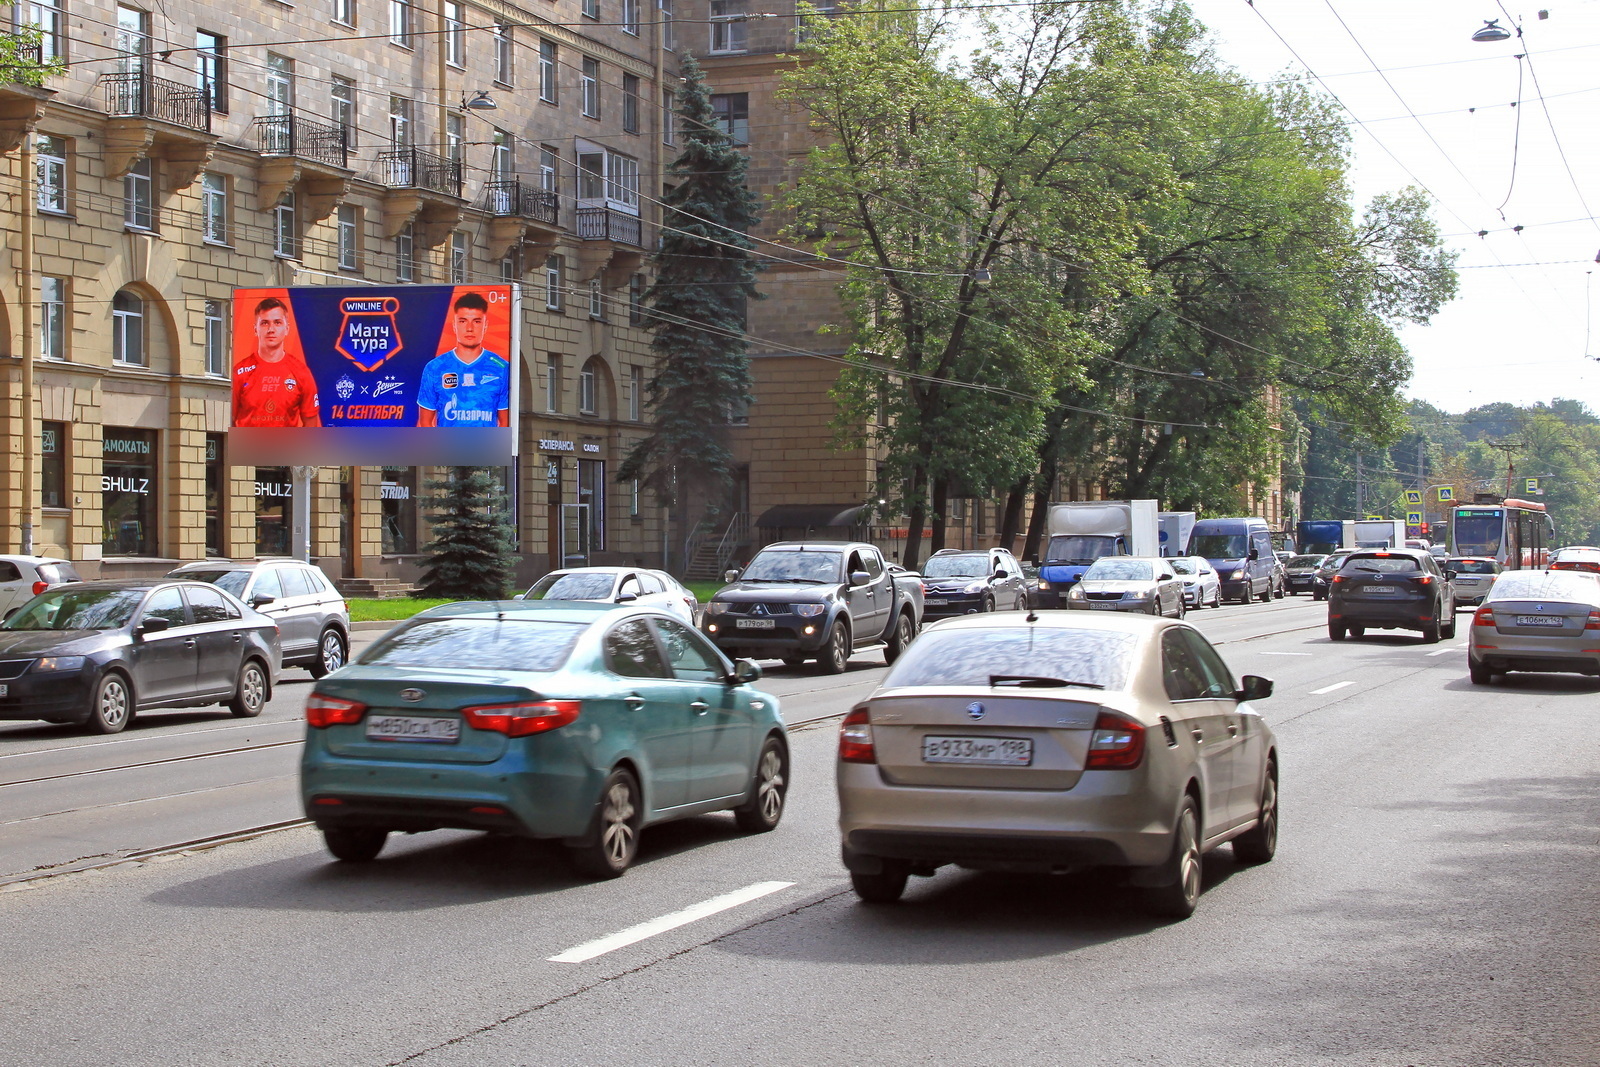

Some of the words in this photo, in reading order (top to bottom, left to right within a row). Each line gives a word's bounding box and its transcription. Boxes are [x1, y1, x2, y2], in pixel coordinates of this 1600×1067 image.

[488, 291, 507, 303] 0+
[346, 302, 382, 311] WINLINE
[349, 322, 389, 337] Матч
[351, 338, 388, 353] тура
[262, 376, 280, 384] FON
[261, 384, 280, 392] BET
[331, 405, 344, 420] 14
[347, 405, 404, 420] СЕНТЯБРЯ
[457, 410, 493, 421] ГАЗПРОМ
[102, 439, 150, 454] АМОКАТЫ
[539, 439, 575, 451] ЭСПЕРАНСА
[583, 444, 600, 453] САЛОН
[101, 476, 149, 493] SHULZ
[254, 482, 292, 497] SHULZ
[381, 486, 410, 500] STRIDA
